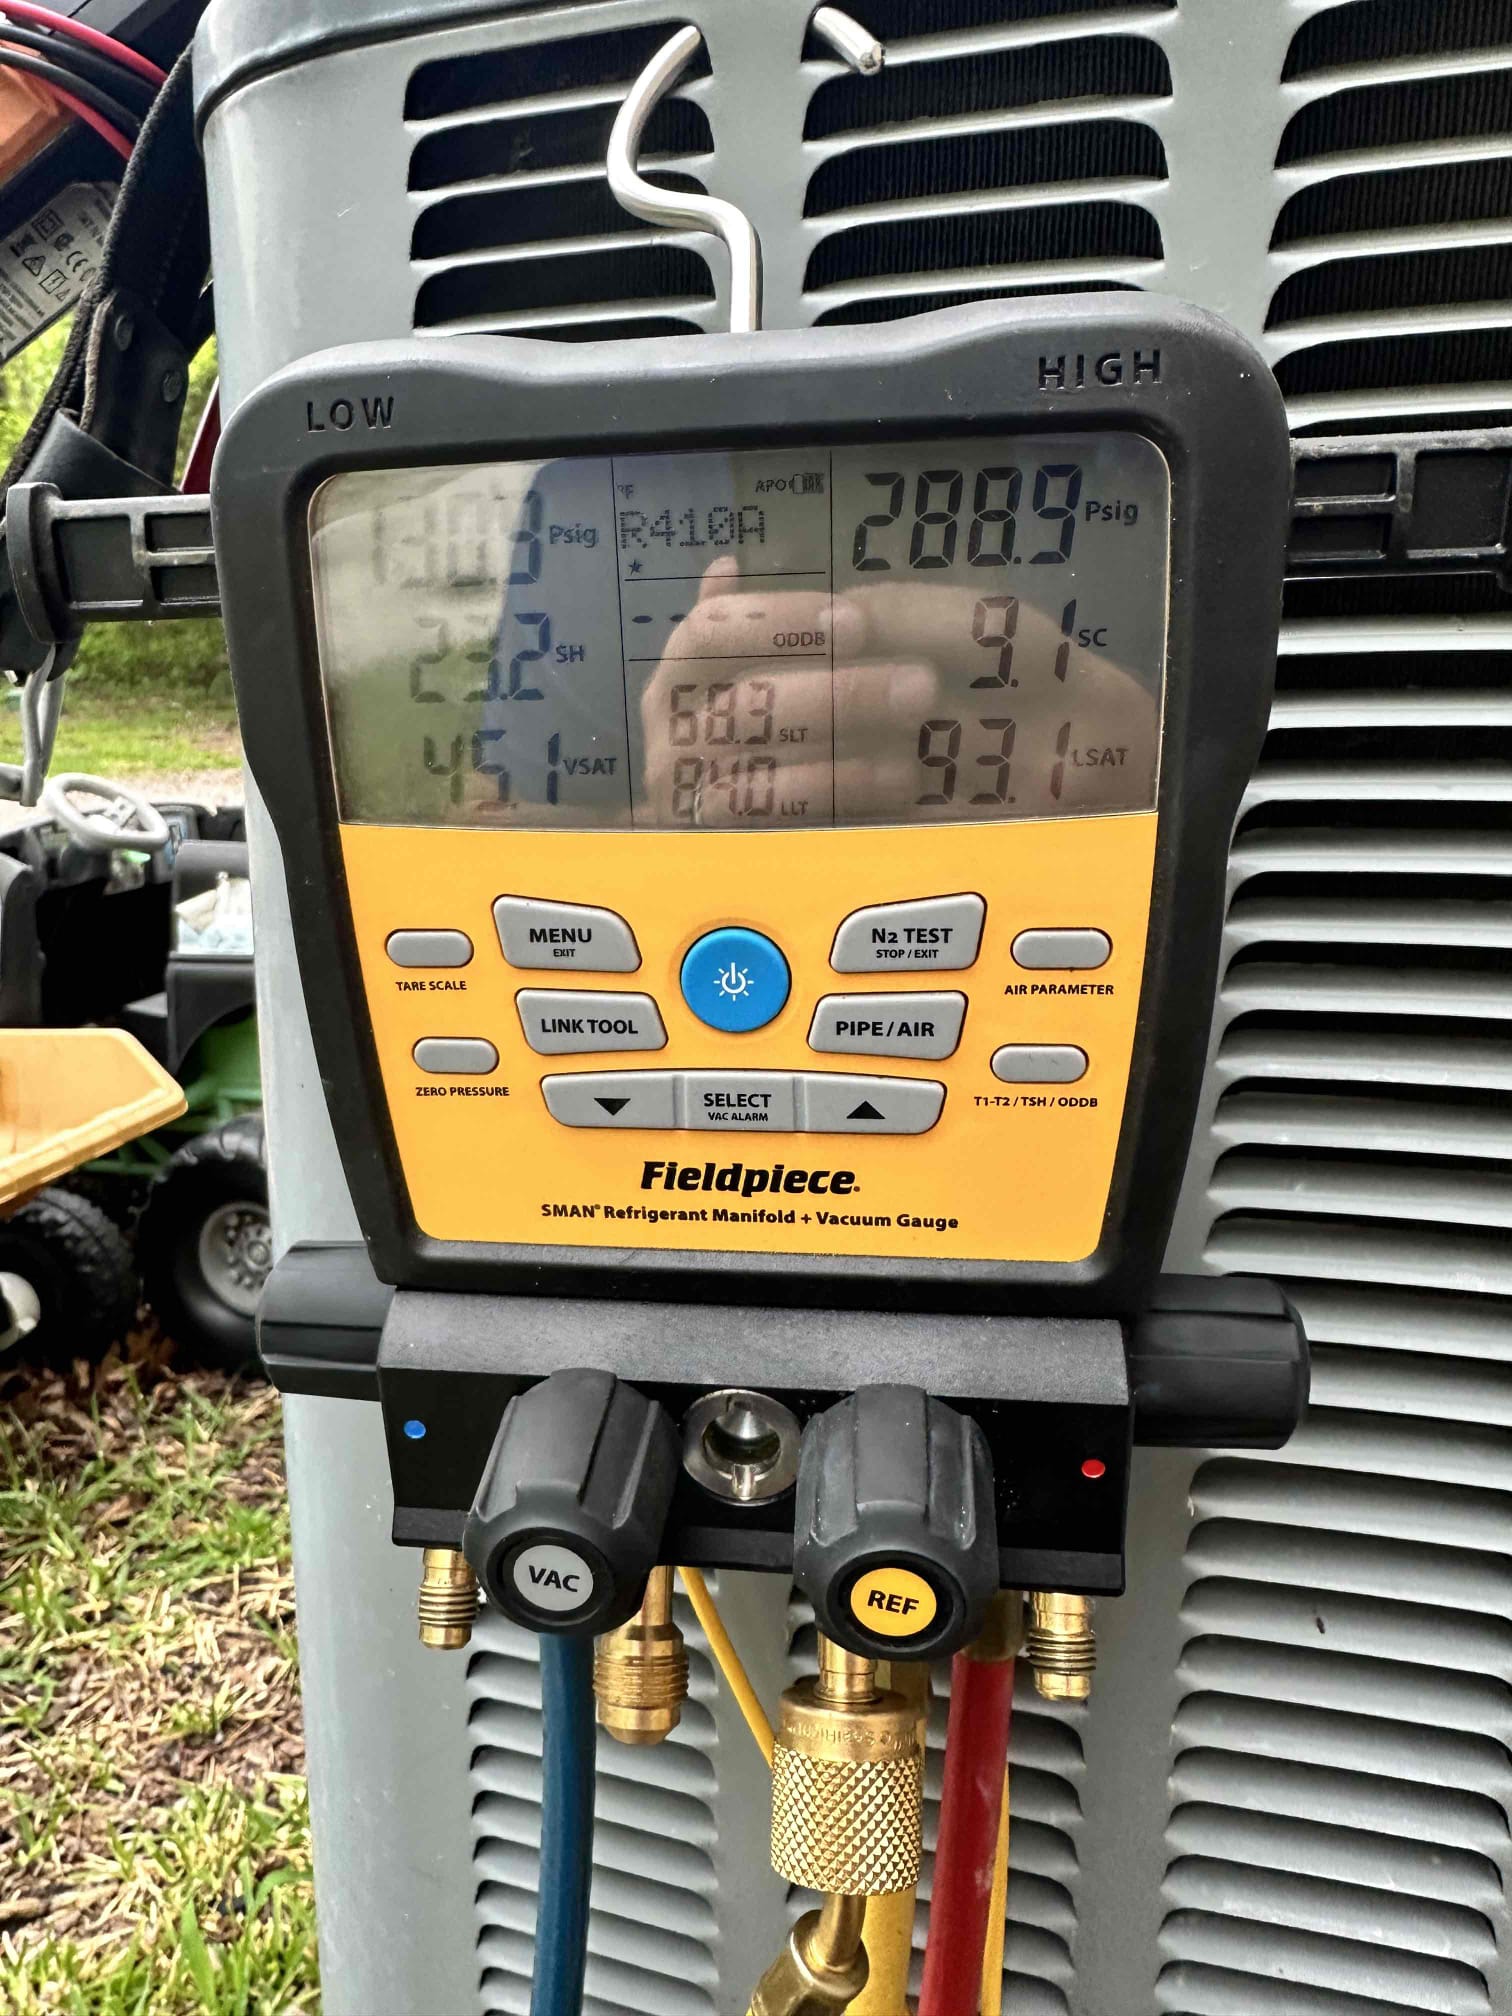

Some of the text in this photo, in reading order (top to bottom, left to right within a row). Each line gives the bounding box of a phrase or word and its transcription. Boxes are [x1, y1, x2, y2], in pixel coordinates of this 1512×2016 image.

[1039, 349, 1163, 392] HIGH
[305, 396, 394, 433] LOW
[852, 463, 1139, 571] 288.9 Psig
[549, 524, 599, 548] Psig
[969, 595, 1108, 689] 9.1 SC
[410, 612, 585, 703] 23.2 SH
[668, 683, 808, 747] 68.3 SLT
[422, 727, 618, 812] 45.1 VSAT
[914, 718, 1129, 805] 93.1 LSAT
[780, 801, 809, 816] LLT
[529, 928, 592, 943] MENU
[903, 927, 953, 944] TEST
[553, 948, 576, 957] EXIT
[876, 949, 905, 959] STOP
[914, 949, 939, 959] EXIT
[395, 980, 468, 992] TARE SCALE
[1004, 983, 1115, 996] AIR PARAMETER
[541, 1018, 638, 1035] LINK TOOL
[836, 1021, 883, 1036] PIPE
[897, 1021, 935, 1037] AIR
[415, 1086, 510, 1097] ZERO PRESSURE
[703, 1093, 772, 1108] SELECT
[974, 1096, 1011, 1107] T1-T2
[1021, 1096, 1047, 1108] TSH
[1057, 1097, 1098, 1108] ODDB
[707, 1112, 769, 1122] VAC ALARM
[640, 1161, 854, 1197] Fieldpiece
[603, 1205, 709, 1224] Refrigerant
[711, 1207, 797, 1225] Manifold
[815, 1210, 892, 1228] Vacuum
[896, 1213, 960, 1231] Gauge
[528, 1565, 580, 1593] VAC
[867, 1590, 919, 1615] REF
